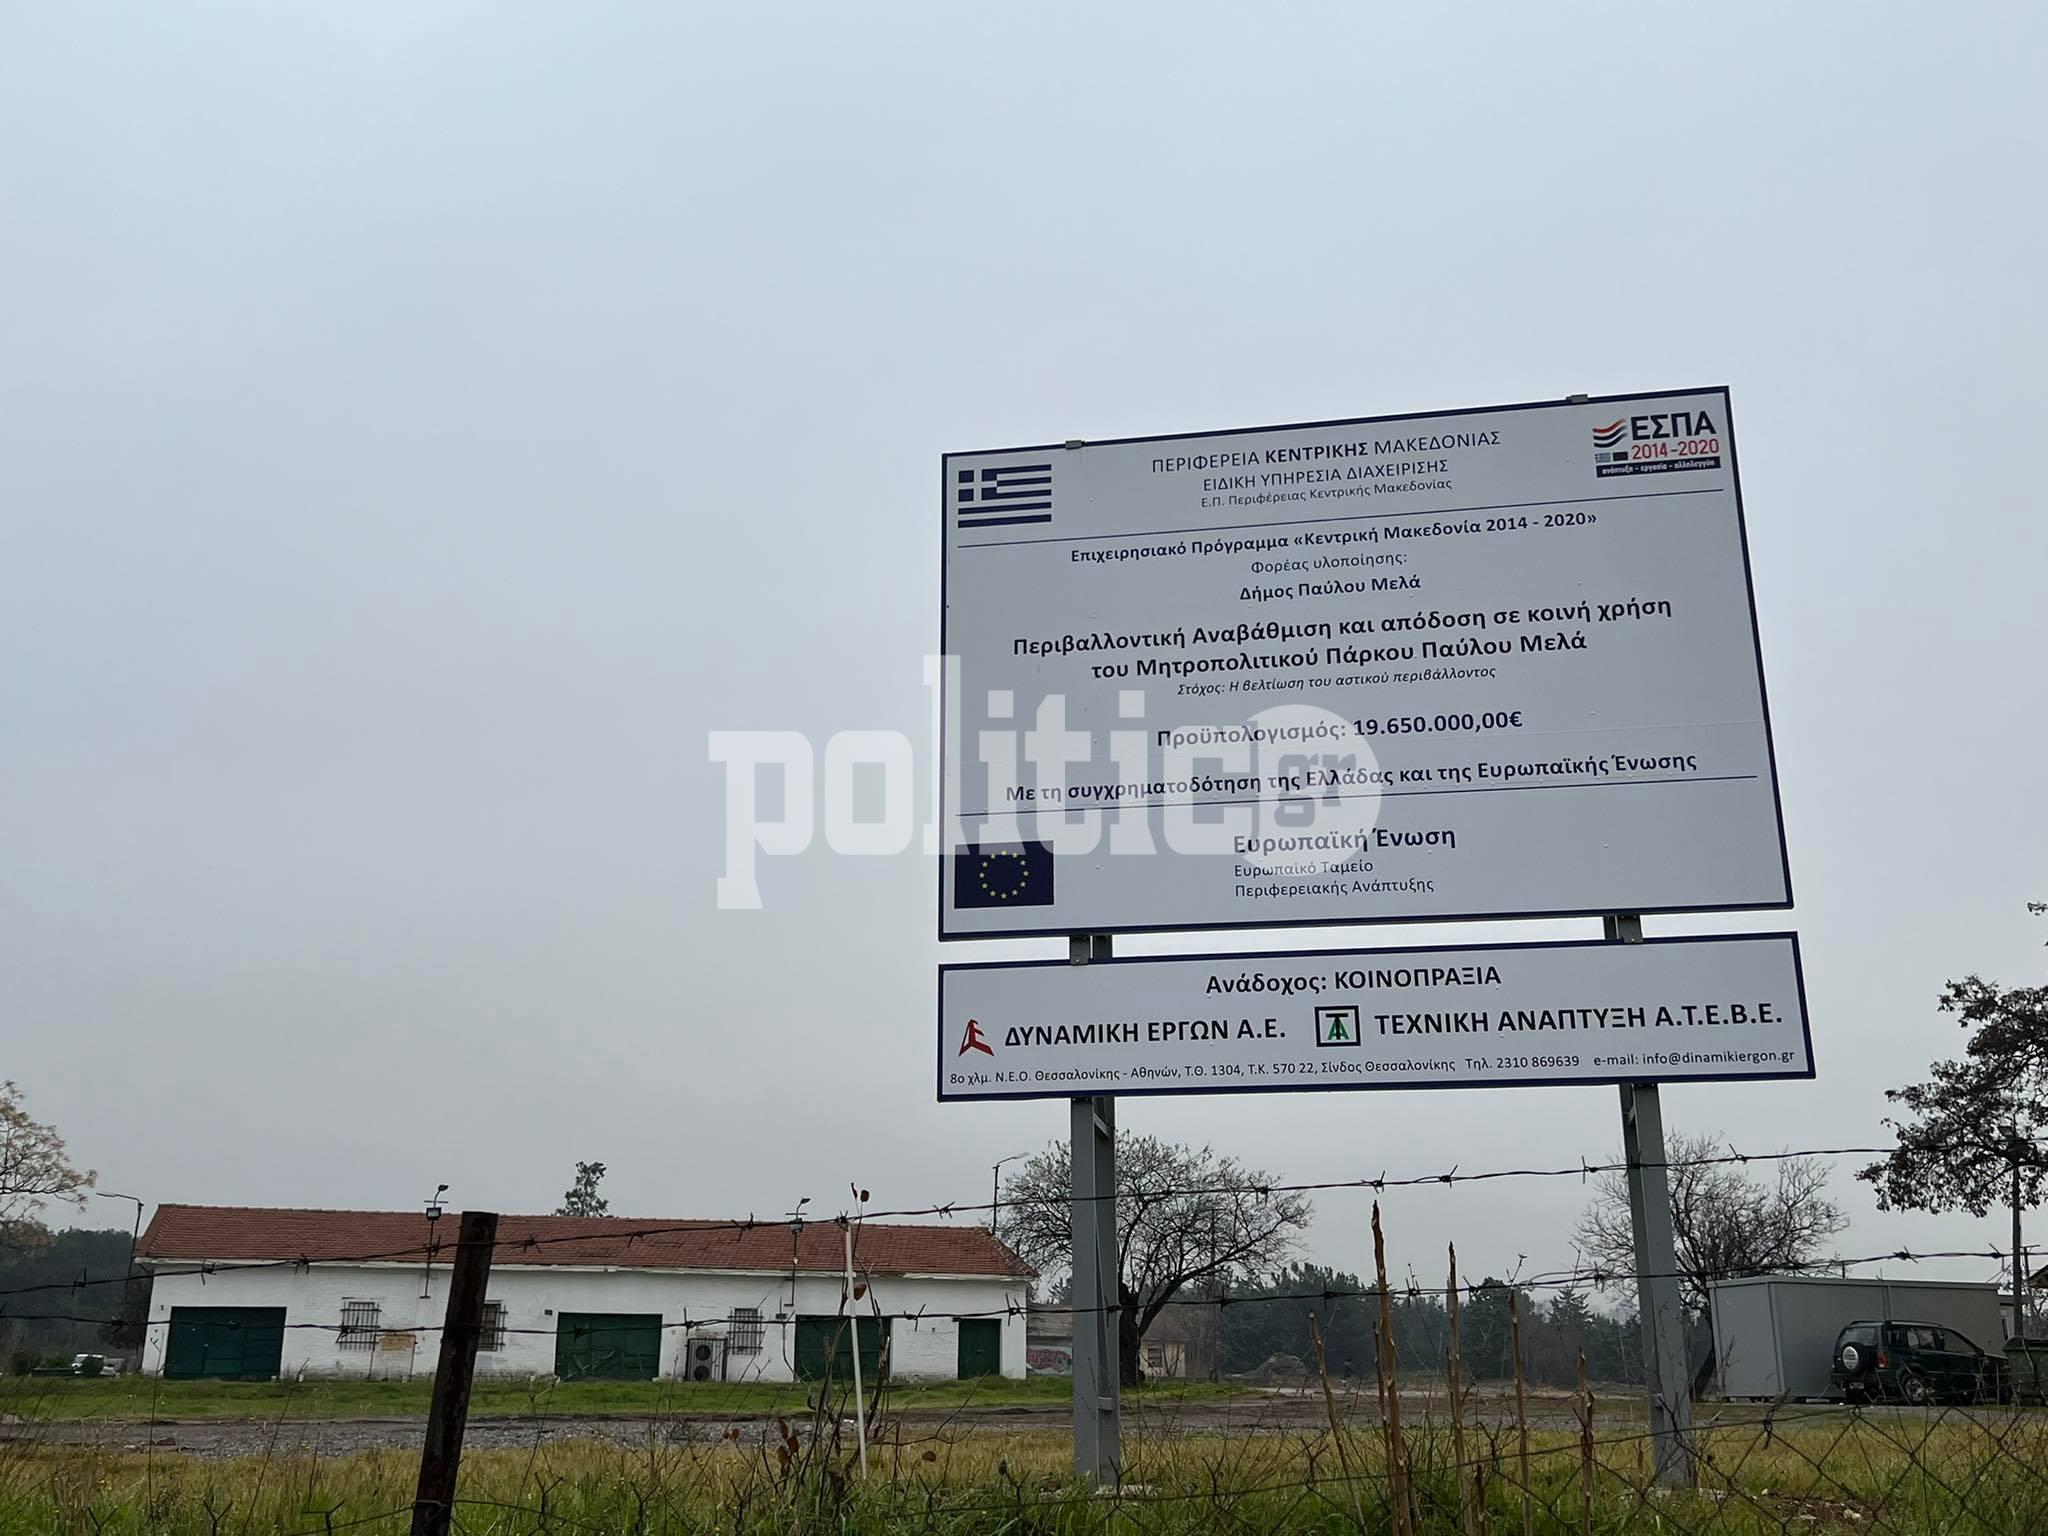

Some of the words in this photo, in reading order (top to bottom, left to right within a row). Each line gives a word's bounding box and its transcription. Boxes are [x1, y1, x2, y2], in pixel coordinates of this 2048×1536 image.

[1631, 411, 1717, 441] ΕΣΠΑ
[1153, 452, 1260, 473] ΠΕΡΙΦΕΡΕΙΑ
[1266, 442, 1368, 463] ΚΕΝΤΡΙΚΗΣ
[1375, 431, 1500, 455] ΜΑΚΕΔΟΝΙΑΣ
[1204, 475, 1255, 491] ΕΙΔΙΚΗ
[1261, 469, 1342, 486] ΥΠΗΡΕΣΙΑ
[1346, 460, 1448, 480] ΔΙΑΧΕΙΡΙΣΗΣ
[1202, 497, 1224, 507] Ε.Π.
[1229, 492, 1306, 506] Περιφέρειας
[1310, 484, 1371, 499] Κεντρικής
[1374, 479, 1452, 494] Μακεδονίας
[1072, 541, 1186, 563] Επιχειρησιακό
[1192, 538, 1289, 556] Πρόγραμμα
[1294, 527, 1378, 546] «Κεντρική
[1384, 520, 1481, 539] Μακεδονία
[1486, 517, 1528, 531] 2014
[1544, 512, 1596, 527] 2020»
[1251, 559, 1309, 574] Φορέας
[1314, 553, 1406, 569] υλοποίησης:
[1240, 585, 1293, 602] Δήμος
[1299, 580, 1365, 596] Παύλου
[1371, 574, 1421, 591] Μελά
[1014, 627, 1185, 657] Περιβαλλοντική
[1192, 622, 1331, 645] Αναβάθμιση
[1339, 620, 1375, 634] και
[1381, 611, 1486, 631] απόδοση
[1493, 611, 1520, 624] σε
[1528, 600, 1591, 623] κοινή
[1597, 597, 1671, 622] χρήση
[1091, 665, 1128, 678] του
[1137, 648, 1318, 678] Μητροπολιτικού
[1326, 645, 1414, 666] Πάρκου
[1422, 638, 1511, 658] Παύλου
[1520, 630, 1587, 652] Μελά
[1177, 683, 1225, 696] Στόχος:
[1229, 681, 1239, 692] Η
[1243, 678, 1304, 691] βελτίωση
[1308, 678, 1331, 687] του
[1336, 672, 1389, 686] αστικού
[1393, 667, 1496, 684] περιβάλλοντος
[1158, 722, 1345, 746] Προϋπολογισμός:
[1354, 711, 1523, 737] 19.650.000,00€
[1007, 786, 1036, 801] Με
[1041, 788, 1061, 802] τη
[1068, 776, 1261, 801] συγχρηματοδότηση
[1267, 774, 1301, 791] της
[1307, 768, 1393, 789] Ελλάδας
[1400, 769, 1432, 782] και
[1437, 767, 1472, 783] της
[1478, 756, 1608, 779] Ευρωπαϊκής
[1611, 754, 1697, 776] Ένωσης
[1234, 828, 1368, 856] Ευρωπαϊκή
[1372, 828, 1455, 849] Ένωση
[1235, 861, 1316, 878] Ευρωπαϊκό
[1321, 859, 1373, 875] Ταμείο
[1235, 881, 1348, 899] Περιφερειακής
[1352, 878, 1434, 893] Ανάπτυξης
[1206, 973, 1326, 995] Ανάδοχος:
[1335, 966, 1502, 989] ΚΟΙΝΟΠΡΑΞΙΑ
[1005, 1023, 1138, 1046] ΔΥΝΑΜΙΚΗ
[1148, 1020, 1228, 1041] ΕΡΓΩΝ
[1237, 1018, 1285, 1039] Α.Ε.
[1374, 1012, 1488, 1035] ΤΕΧΝΙΚΗ
[1498, 1007, 1645, 1031] ΑΝΑΠΤΥΞΗ
[1655, 1003, 1782, 1026] Α.Τ.Ε.Β.Ε.
[968, 1072, 992, 1086] χλμ.
[996, 1071, 1031, 1082] Ν.Ε.Ο.
[1035, 1068, 1120, 1081] Θεσσαλονίκης
[1131, 1066, 1181, 1080] Αθηνών,
[1184, 1066, 1208, 1076] Τ.Θ.
[1211, 1065, 1244, 1077] 1304,
[1248, 1064, 1269, 1075] Τ.Κ.
[1273, 1063, 1295, 1074] 570
[1299, 1063, 1317, 1075] 22,
[1321, 1061, 1361, 1074] Σίνδος
[1365, 1059, 1455, 1072] Θεσσαλονίκης
[1465, 1057, 1492, 1071] Τηλ.
[1497, 1057, 1528, 1068] 2310
[1529, 1056, 1579, 1068] 869639
[1594, 1054, 1639, 1066] e-mail:
[1642, 1050, 1795, 1065] info@dinamikiergon.gr
